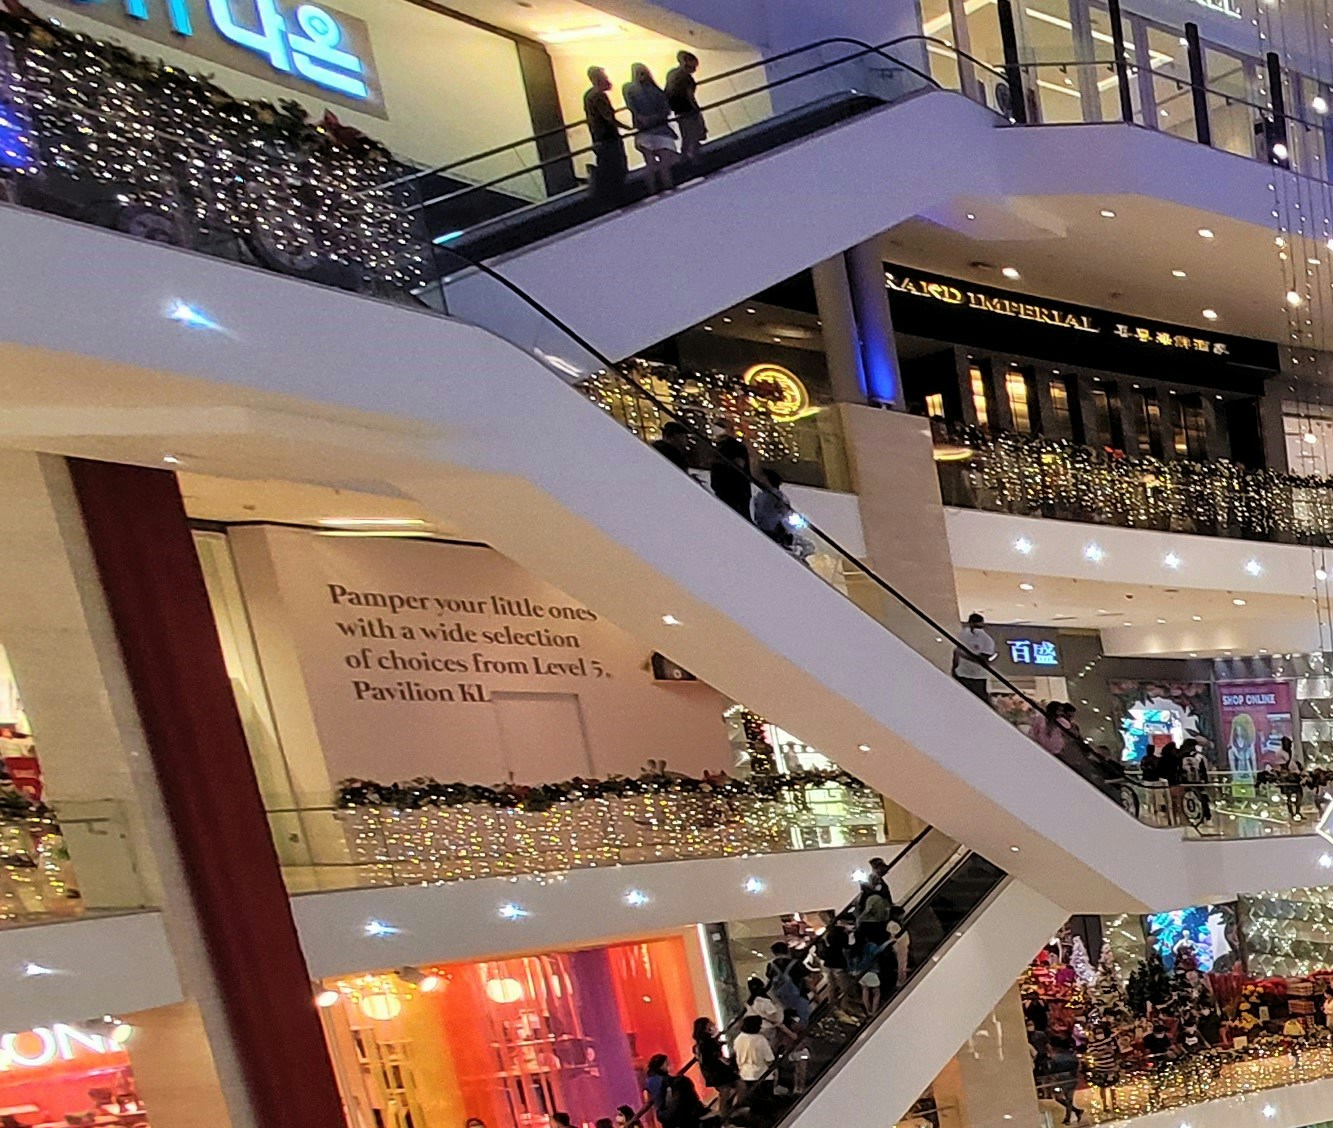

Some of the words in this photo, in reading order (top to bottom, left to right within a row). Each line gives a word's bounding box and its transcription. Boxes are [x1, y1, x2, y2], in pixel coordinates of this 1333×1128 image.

[967, 291, 1099, 333] IMPERIAL
[327, 583, 429, 614] Pamper
[434, 597, 488, 617] your
[490, 595, 545, 618] little
[548, 604, 598, 622] ones
[335, 617, 397, 640] with
[402, 624, 416, 640] a
[420, 622, 478, 644] wide
[482, 628, 581, 648] selection
[345, 648, 372, 669] of
[378, 650, 468, 673] choices
[471, 652, 529, 675] from
[532, 656, 587, 677] Level
[1006, 639, 1059, 666] 百盛
[350, 680, 455, 702] Pavilion
[457, 683, 493, 703] KL
[1222, 694, 1244, 706] SHOP
[1245, 693, 1277, 706] ONLINE
